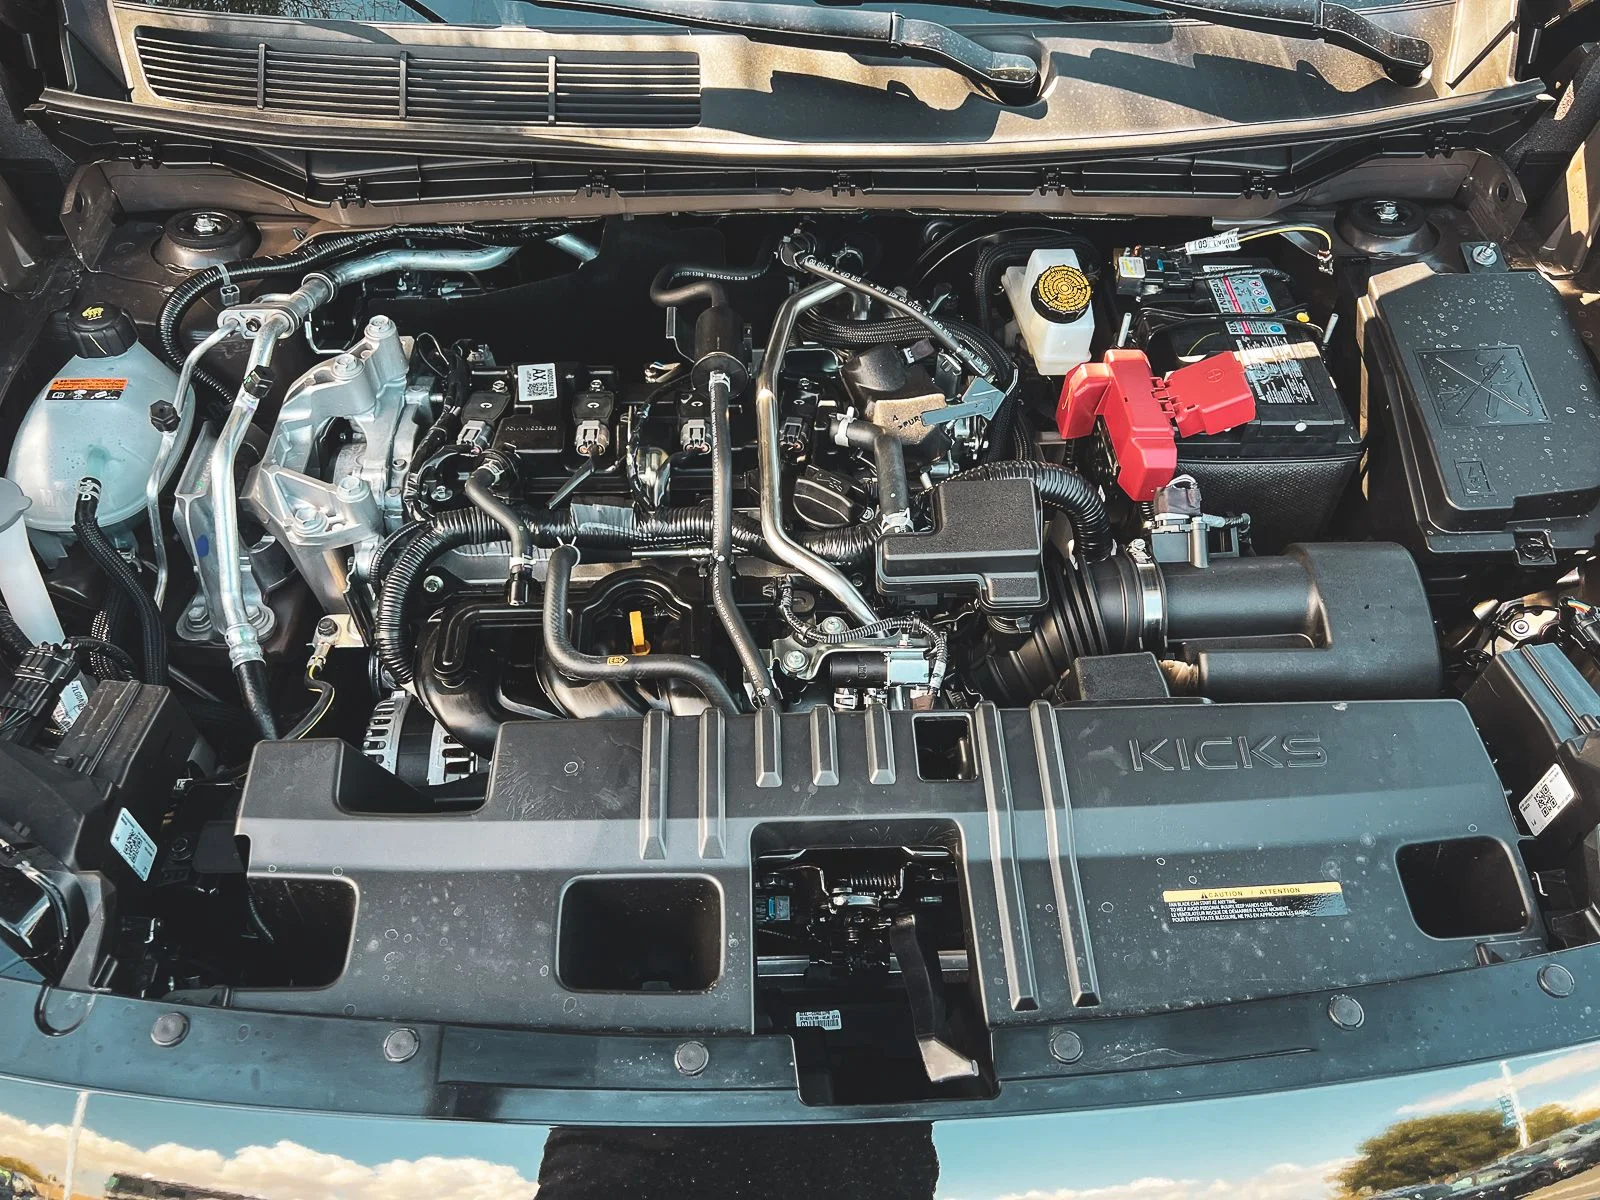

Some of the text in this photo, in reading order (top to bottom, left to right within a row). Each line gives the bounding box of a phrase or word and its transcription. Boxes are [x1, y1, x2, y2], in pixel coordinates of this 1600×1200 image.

[532, 368, 547, 381] AX
[1129, 736, 1327, 771] KICKS
[1259, 887, 1301, 895] ATTENTION
